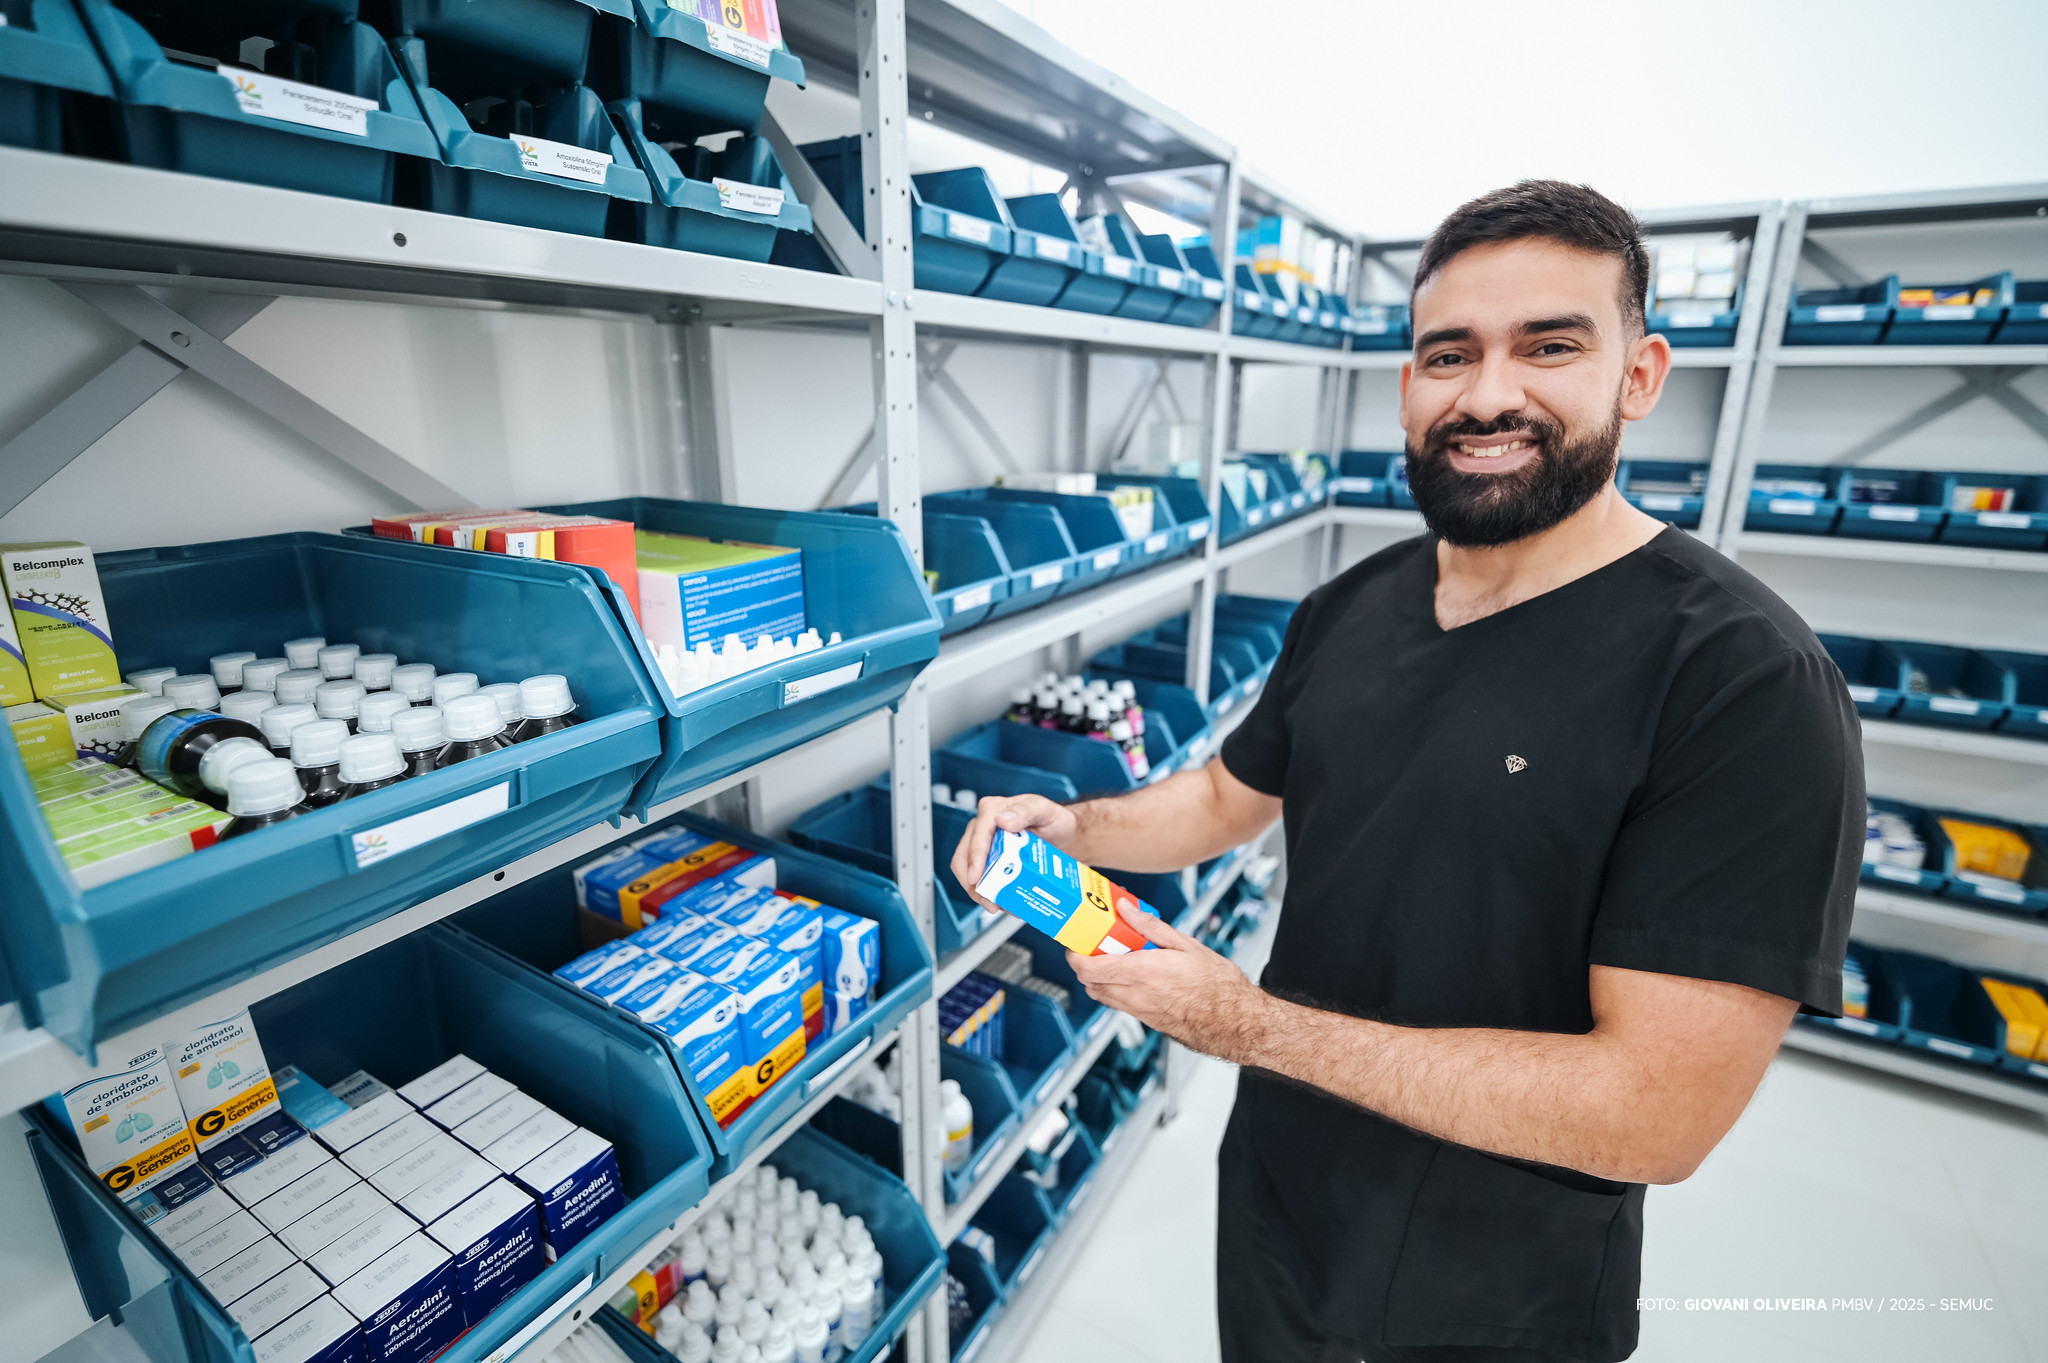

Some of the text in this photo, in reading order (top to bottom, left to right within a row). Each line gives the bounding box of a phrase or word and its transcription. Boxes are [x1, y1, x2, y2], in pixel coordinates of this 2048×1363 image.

[725, 7, 742, 28] G
[304, 103, 353, 120] Solução Oral
[556, 153, 585, 164] Amoxicilina
[562, 162, 590, 173] Suspensão
[13, 558, 84, 572] Belcomplex
[75, 709, 120, 724] Belcom
[1086, 892, 1109, 912] G
[180, 1027, 244, 1063] de ambroxol
[185, 1025, 235, 1052] cloridrato
[128, 1049, 158, 1067] TEUTO
[757, 1059, 774, 1084] G
[86, 1076, 159, 1116] de ambroxol
[92, 1073, 149, 1104] cloridrato
[196, 1085, 271, 1136] G Medicamento
[228, 1091, 274, 1121] Genérico
[140, 1120, 181, 1144] EXPECTORANTE
[103, 1166, 135, 1193] G
[136, 1137, 188, 1168] Medicamento
[138, 1144, 191, 1177] Genérico
[565, 1172, 607, 1210] Aerodini
[561, 1187, 615, 1229] 100mcg/jato-dose
[561, 1206, 579, 1221] sulfato
[466, 1238, 490, 1260] TEUTO
[474, 1266, 494, 1282] sulfato
[494, 1260, 502, 1268] de
[502, 1236, 532, 1261] salbutamol
[478, 1230, 526, 1271] Aerodini
[474, 1244, 534, 1291] 100mcg/jato-dose
[374, 1300, 401, 1325] TEUTO
[384, 1330, 407, 1348] sulfato
[407, 1323, 416, 1331] de
[416, 1295, 450, 1324] salbutamol
[389, 1288, 443, 1336] Aerodini
[384, 1303, 453, 1358] 100mcg/jato-dose
